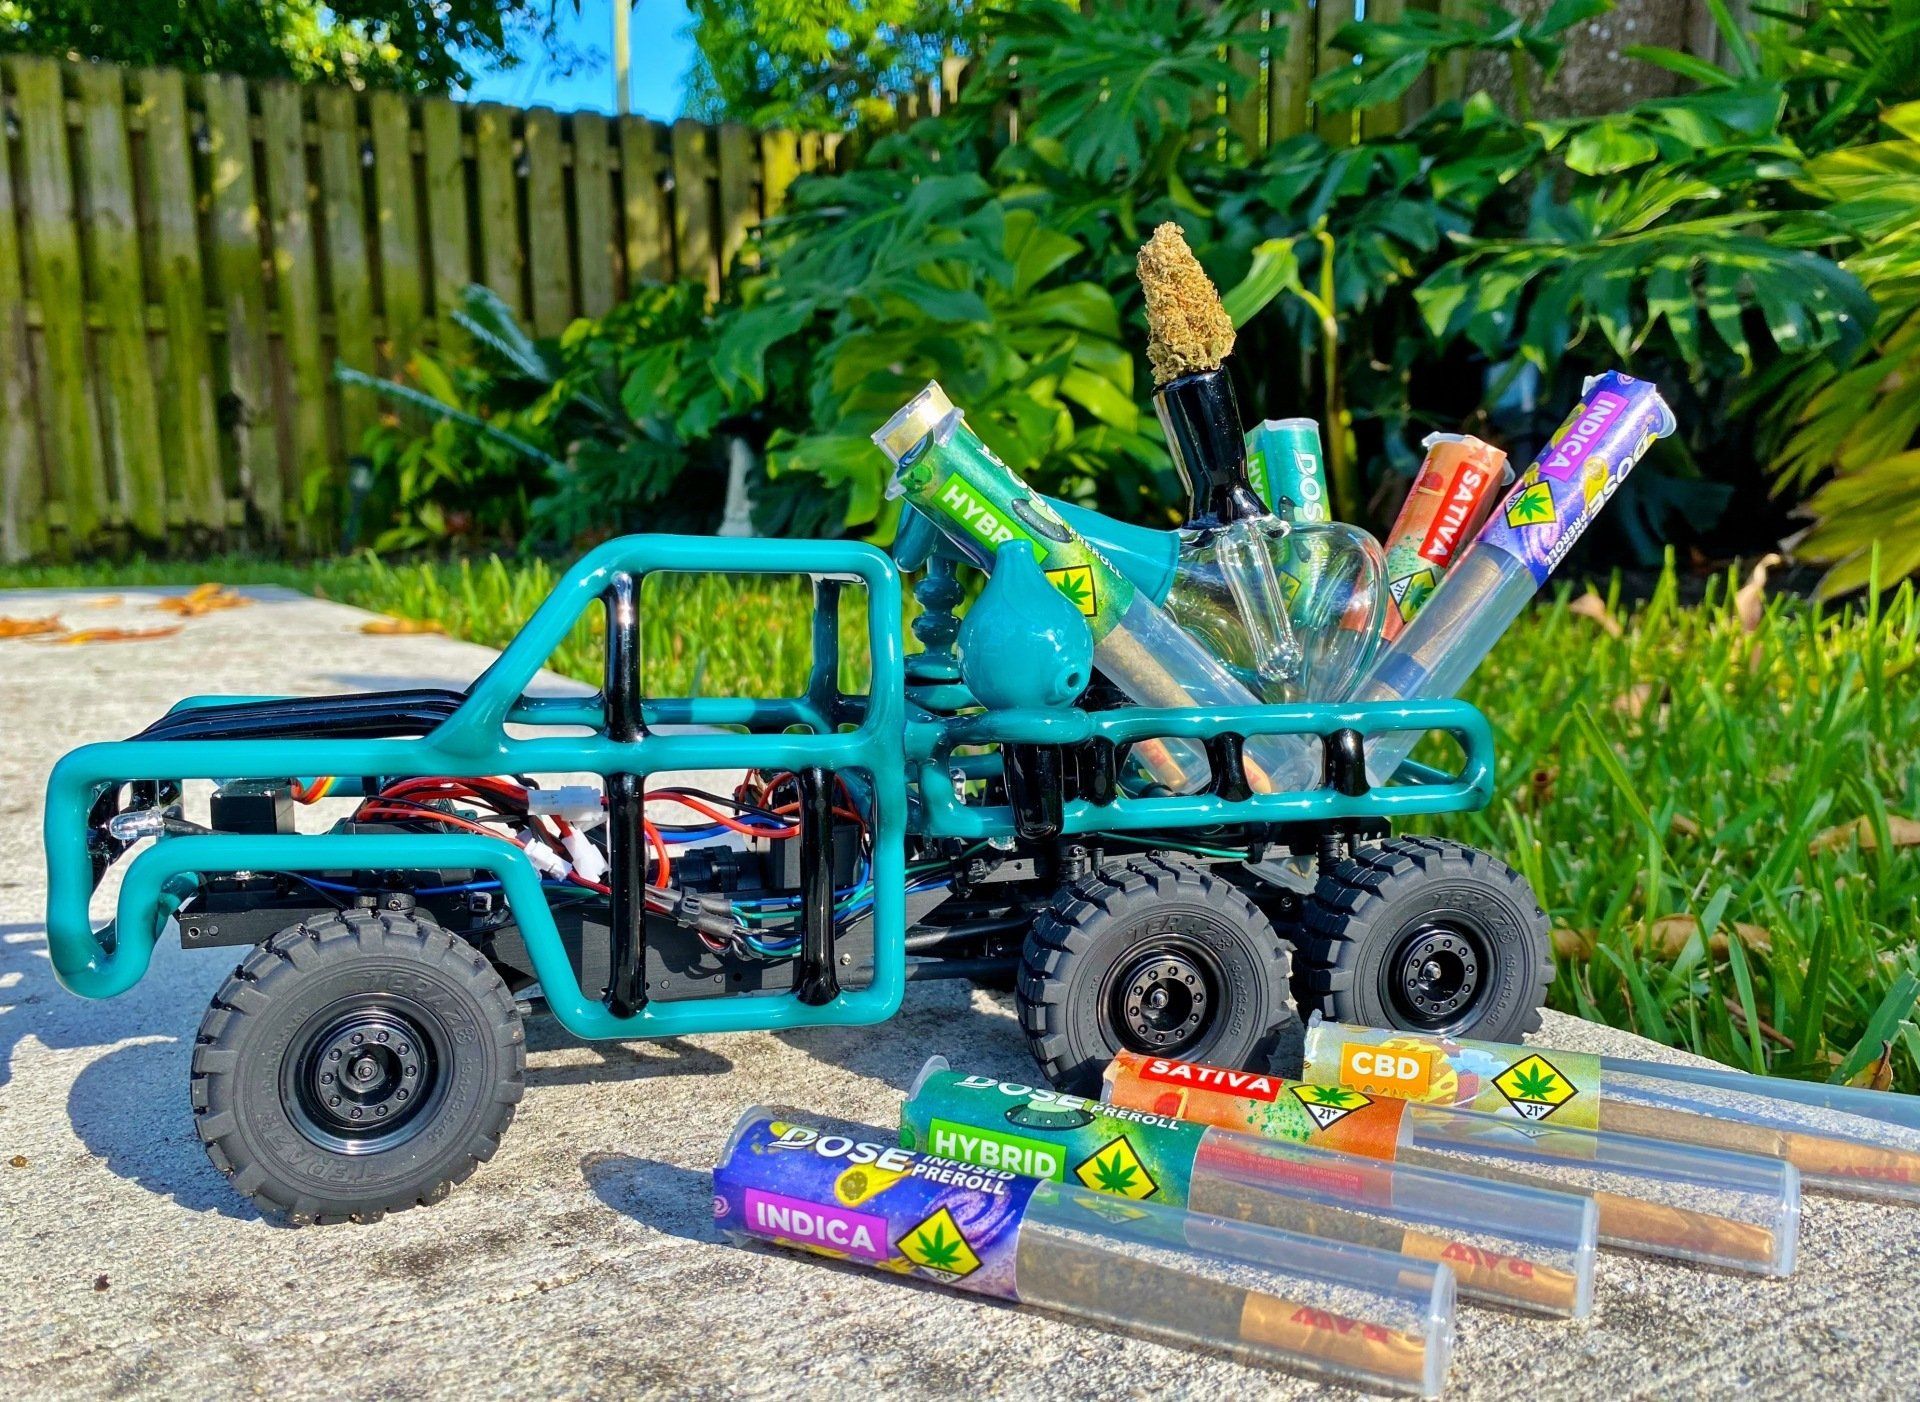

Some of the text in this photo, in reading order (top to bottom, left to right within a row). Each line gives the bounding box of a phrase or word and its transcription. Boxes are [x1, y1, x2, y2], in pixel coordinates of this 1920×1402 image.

[1549, 399, 1617, 468] INDICA
[942, 485, 1014, 545] HYBR
[1428, 469, 1482, 557] SATIVA
[1543, 510, 1587, 565] PREROLL
[1149, 1060, 1271, 1094] SATIVA
[1351, 1052, 1420, 1080] CBD
[954, 1075, 1088, 1110] DOSE
[1525, 1103, 1545, 1117] 21+
[1090, 1104, 1180, 1131] PREROLL
[1318, 1108, 1338, 1120] 21+
[767, 1126, 916, 1173] DOSE
[936, 1129, 1057, 1178] HYBRID
[911, 1163, 1006, 1196] PREROLL
[923, 1154, 1017, 1182] INFUSED
[756, 1201, 877, 1253] INDICA
